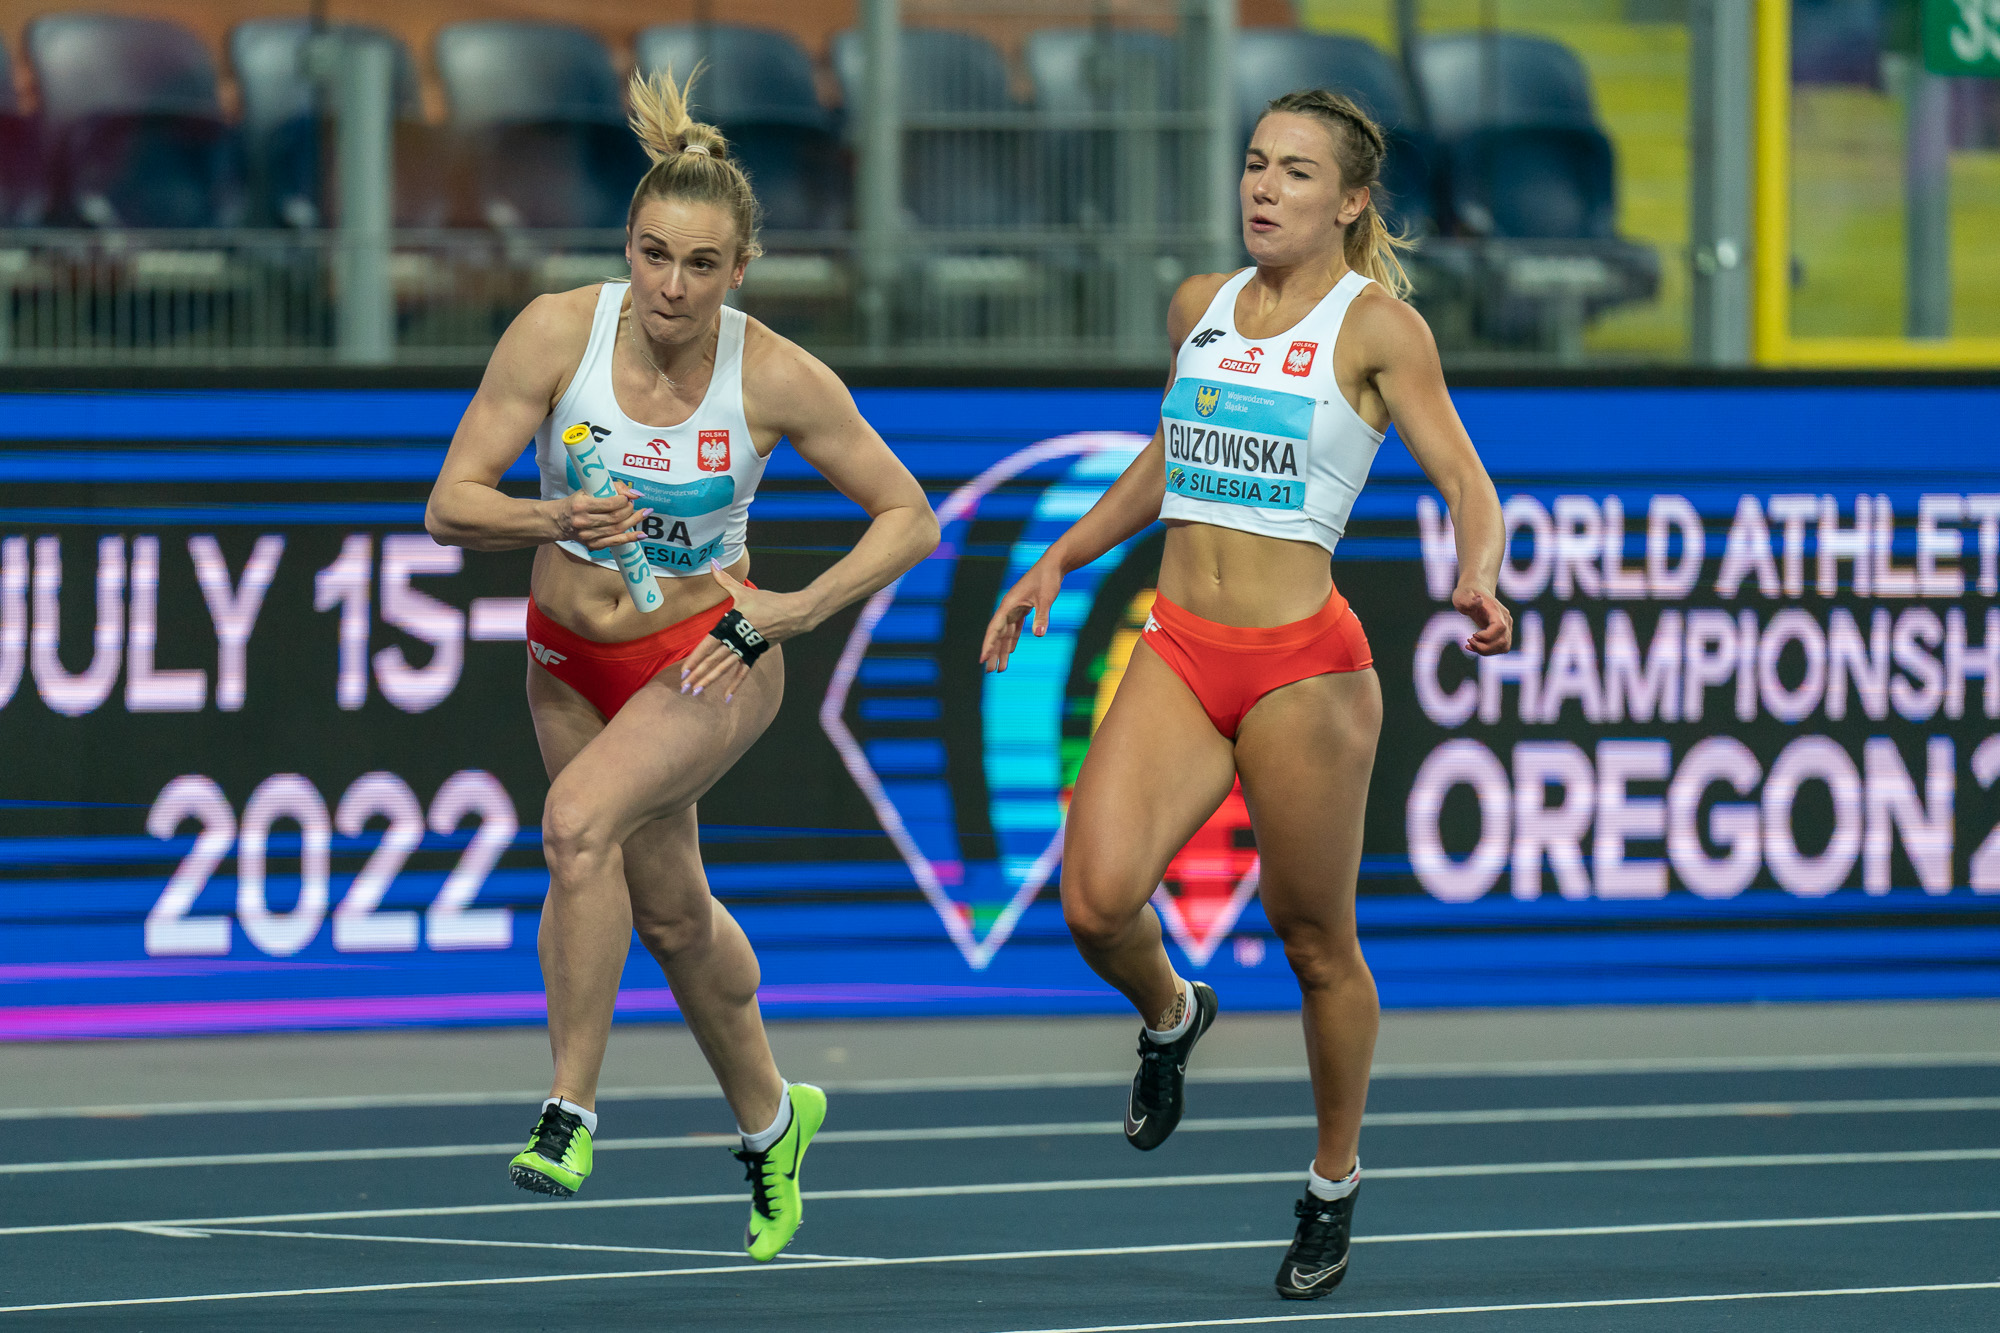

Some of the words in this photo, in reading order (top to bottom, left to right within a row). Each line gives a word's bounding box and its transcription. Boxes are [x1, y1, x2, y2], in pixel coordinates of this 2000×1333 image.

[1221, 360, 1258, 373] ORLEN
[1228, 391, 1275, 406] Województwo
[625, 455, 668, 470] ORLEN
[1170, 423, 1298, 476] GUZOWSKA
[1190, 473, 1262, 501] SILESIA
[1269, 485, 1291, 503] 21
[646, 590, 656, 603] 6
[1413, 606, 2000, 727] CHAMPIONSH
[1405, 735, 1956, 904] OREGON
[145, 768, 519, 957] 2022
